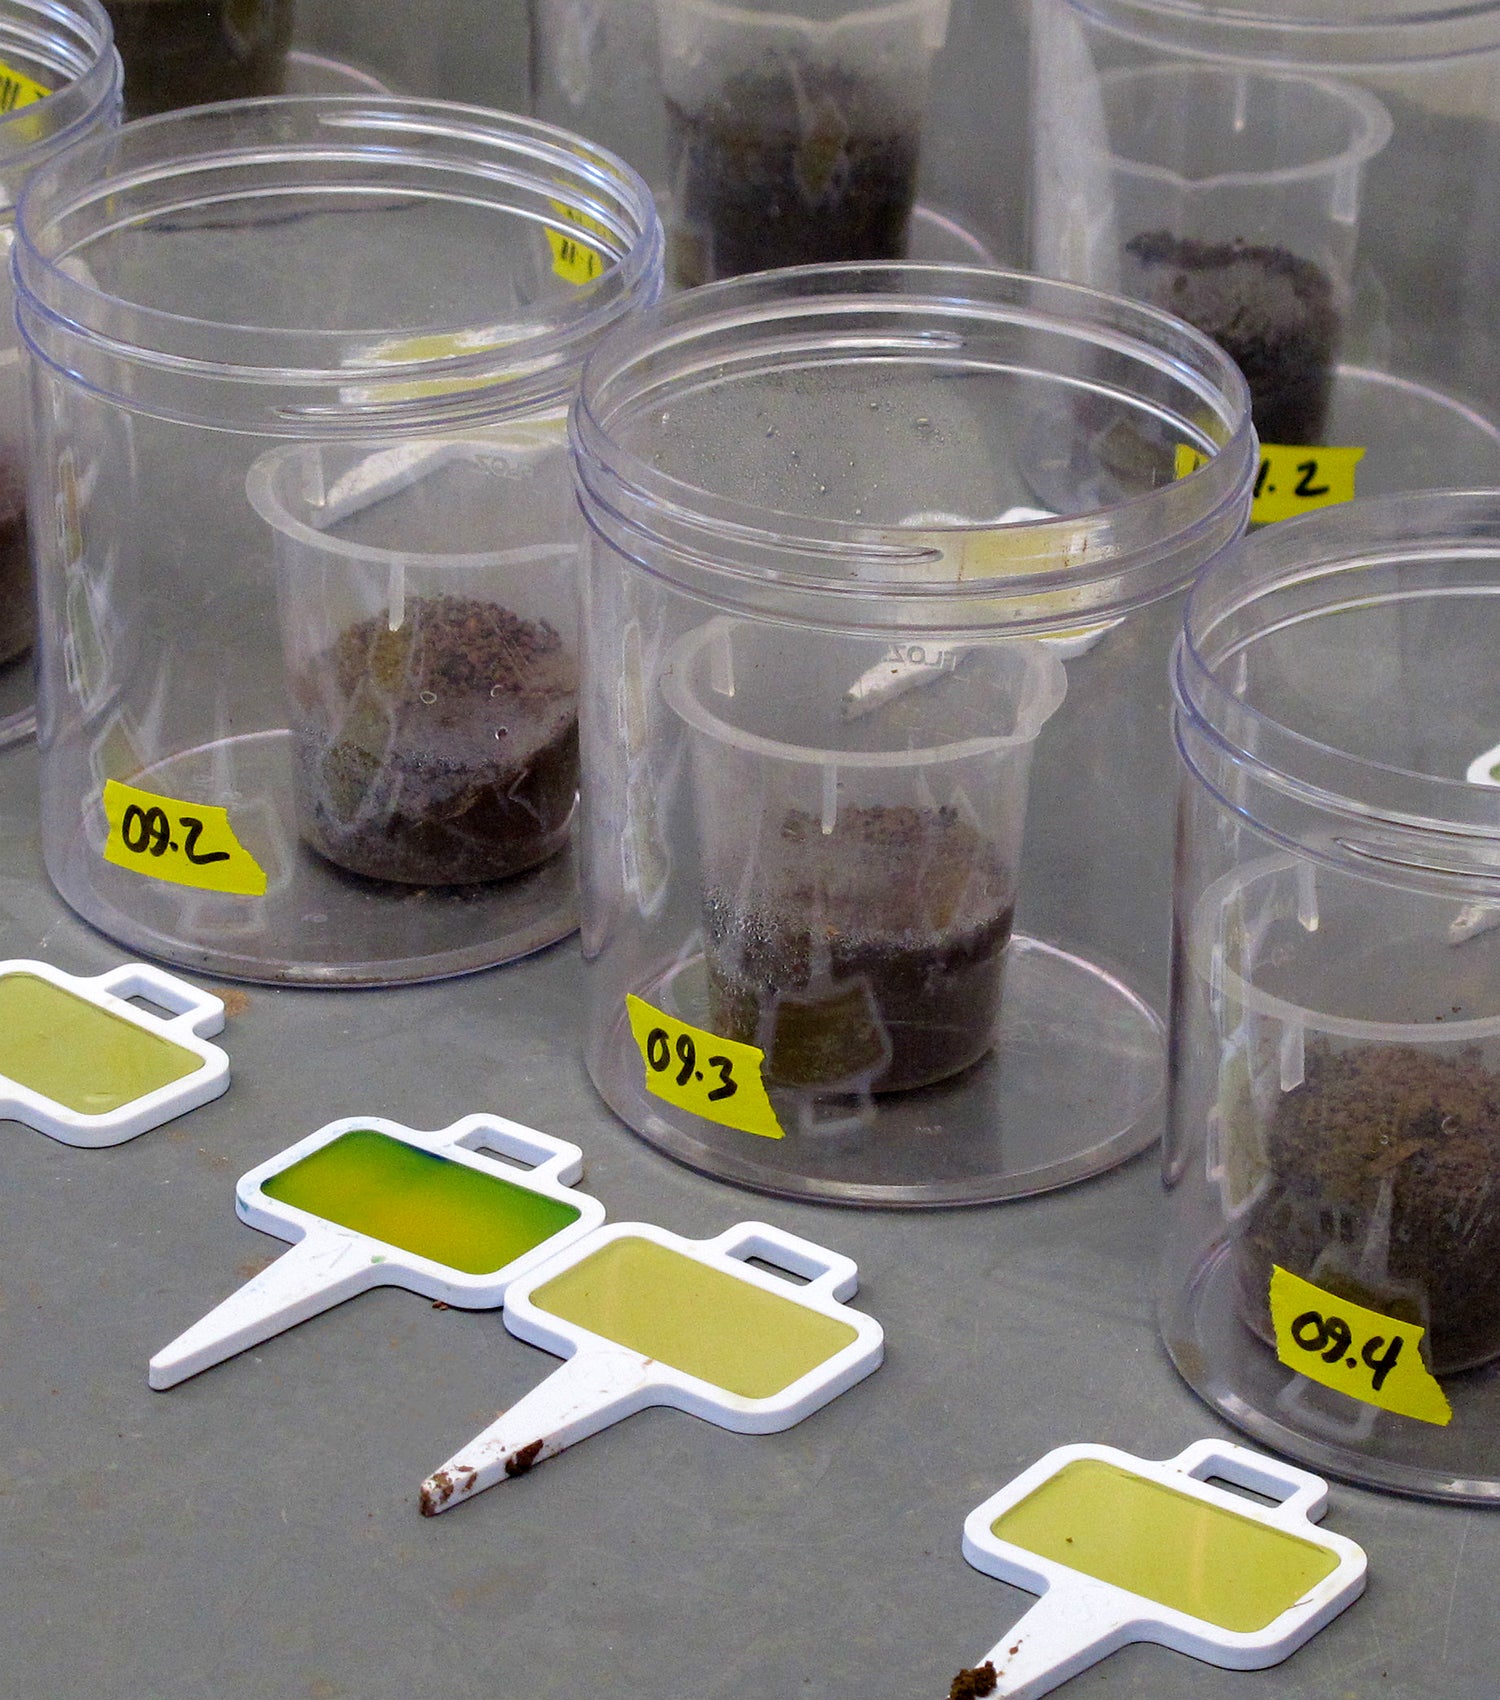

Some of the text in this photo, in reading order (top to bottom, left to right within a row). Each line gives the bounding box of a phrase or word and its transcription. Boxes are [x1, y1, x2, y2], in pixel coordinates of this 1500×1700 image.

[121, 804, 231, 865] 09.2
[647, 1027, 738, 1102] 09.3
[1291, 1310, 1404, 1391] 09.4
